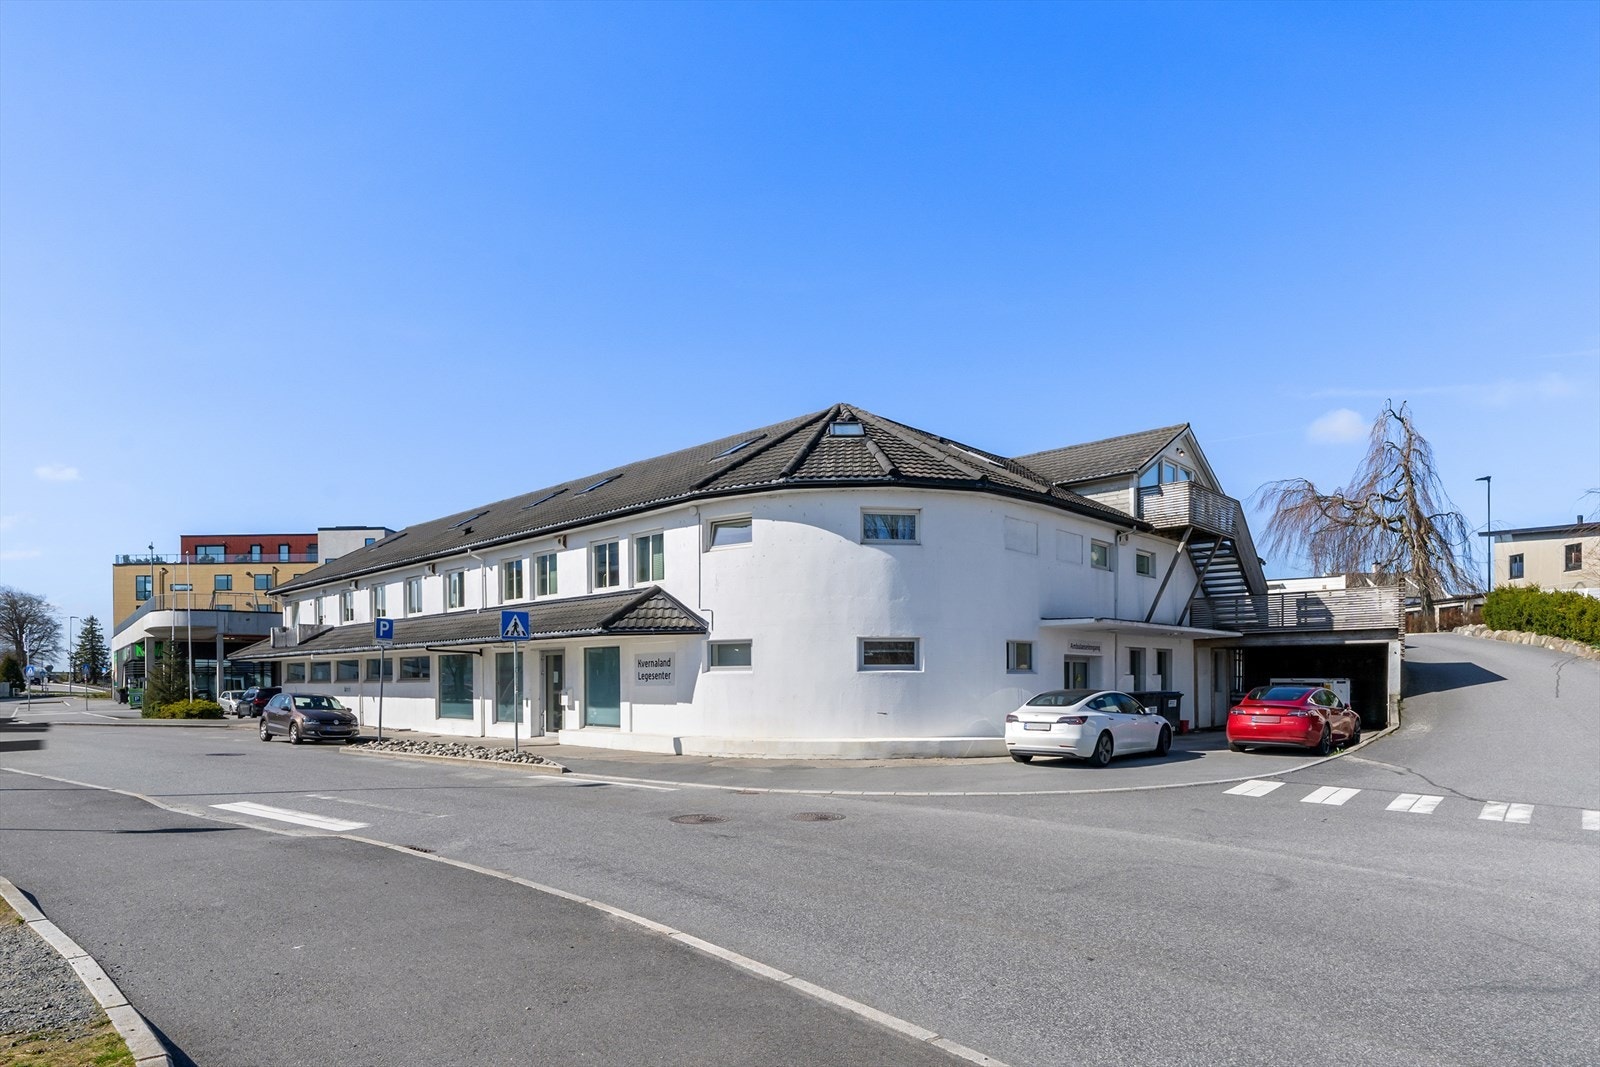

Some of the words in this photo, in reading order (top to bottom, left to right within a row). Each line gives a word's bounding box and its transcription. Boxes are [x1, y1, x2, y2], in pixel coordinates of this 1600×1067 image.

[379, 620, 389, 636] P
[638, 657, 671, 668] Kvernaland
[638, 671, 671, 682] Legesenter
